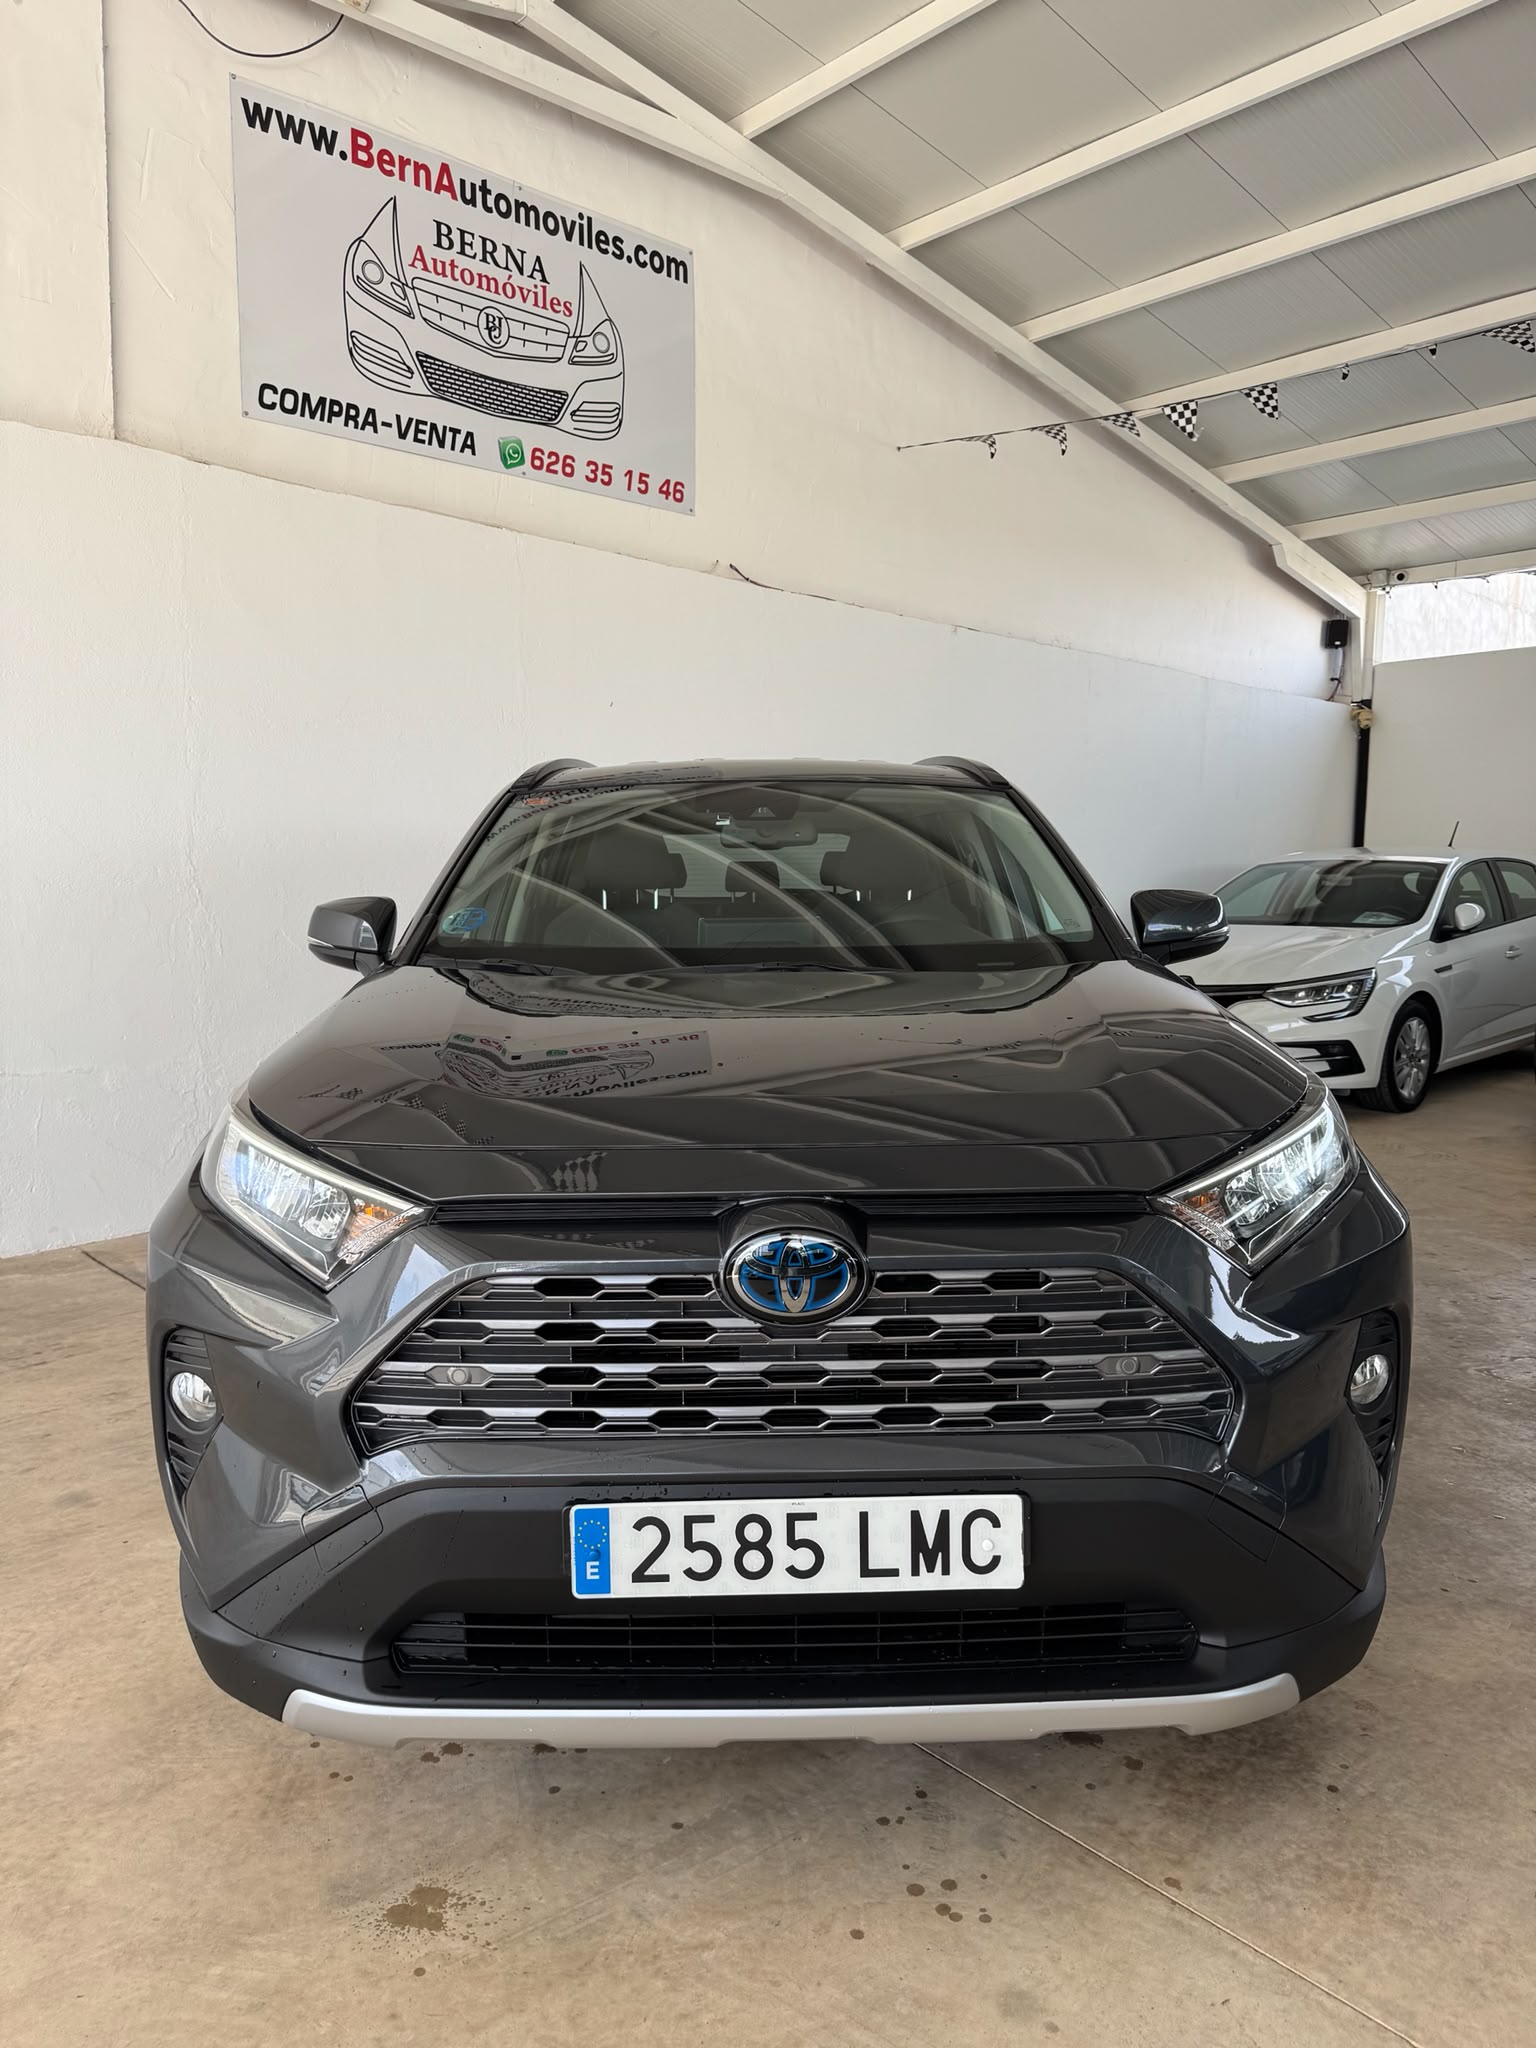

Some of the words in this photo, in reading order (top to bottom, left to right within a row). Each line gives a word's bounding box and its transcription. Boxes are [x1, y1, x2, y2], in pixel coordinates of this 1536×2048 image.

[241, 97, 688, 283] www.BernAutomoviles.com
[408, 245, 573, 317] Automóviles
[433, 219, 550, 284] BERNA
[258, 383, 477, 456] COMPRA-VENTA
[529, 447, 576, 478] 626
[585, 460, 614, 487] 35
[624, 470, 651, 494] 15
[658, 478, 686, 503] 46
[586, 1561, 600, 1580] E
[631, 1512, 825, 1583] 2585
[859, 1508, 1002, 1578] LMC
